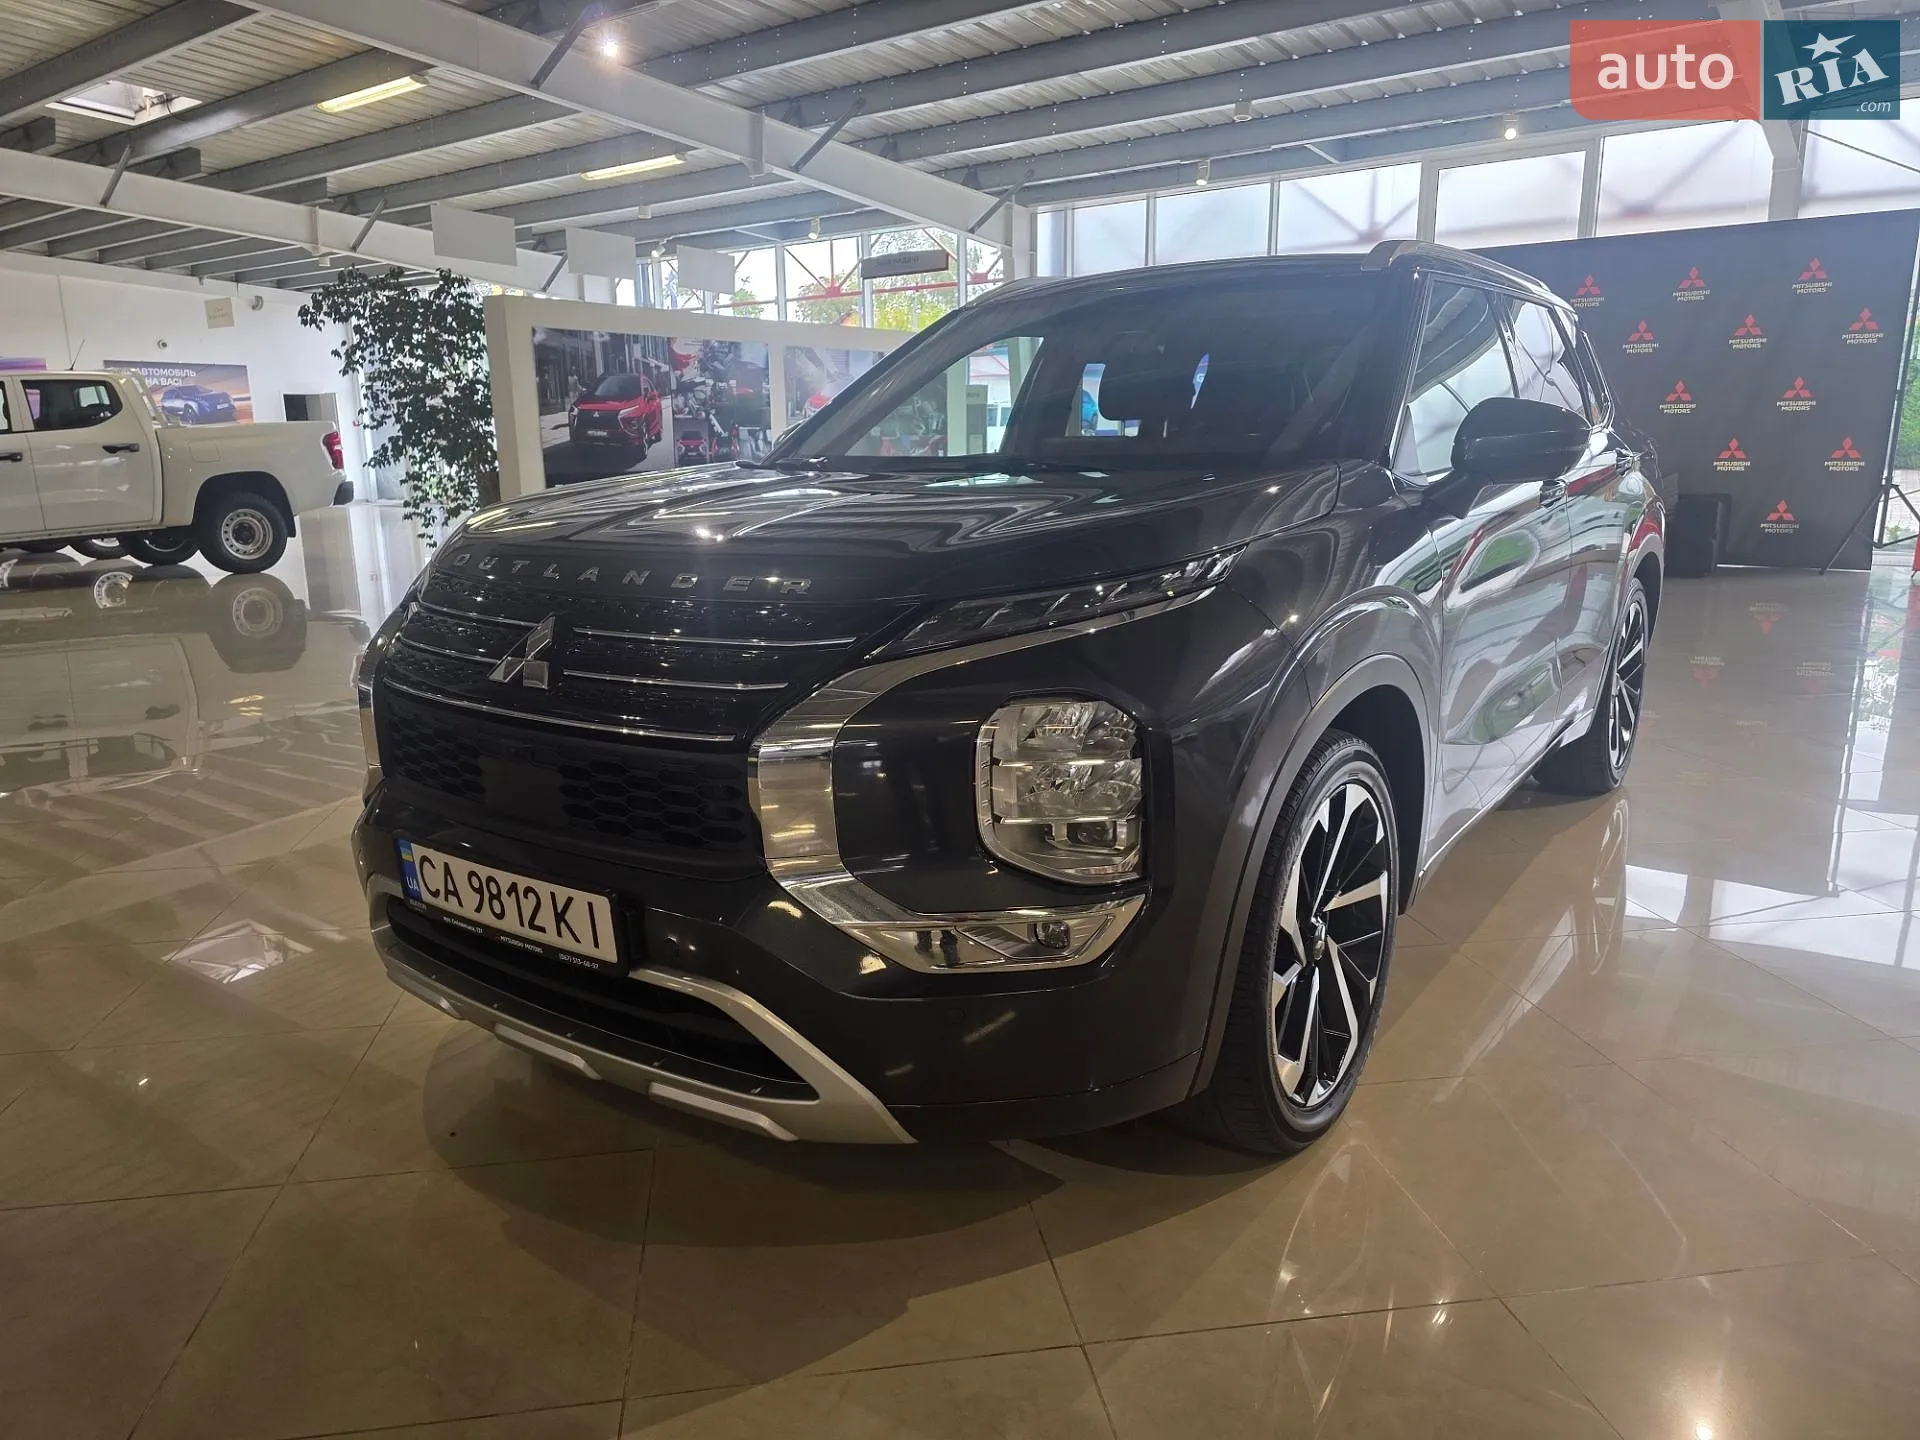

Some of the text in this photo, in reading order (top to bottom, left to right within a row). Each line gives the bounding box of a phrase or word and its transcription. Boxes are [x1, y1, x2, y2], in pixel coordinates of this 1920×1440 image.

[1792, 282, 1833, 290] MITSUBISHI
[1728, 337, 1767, 345] MITSUBISHI
[454, 553, 812, 594] OUTLANDER
[406, 877, 419, 890] UA
[419, 855, 600, 950] CA 9812 KI
